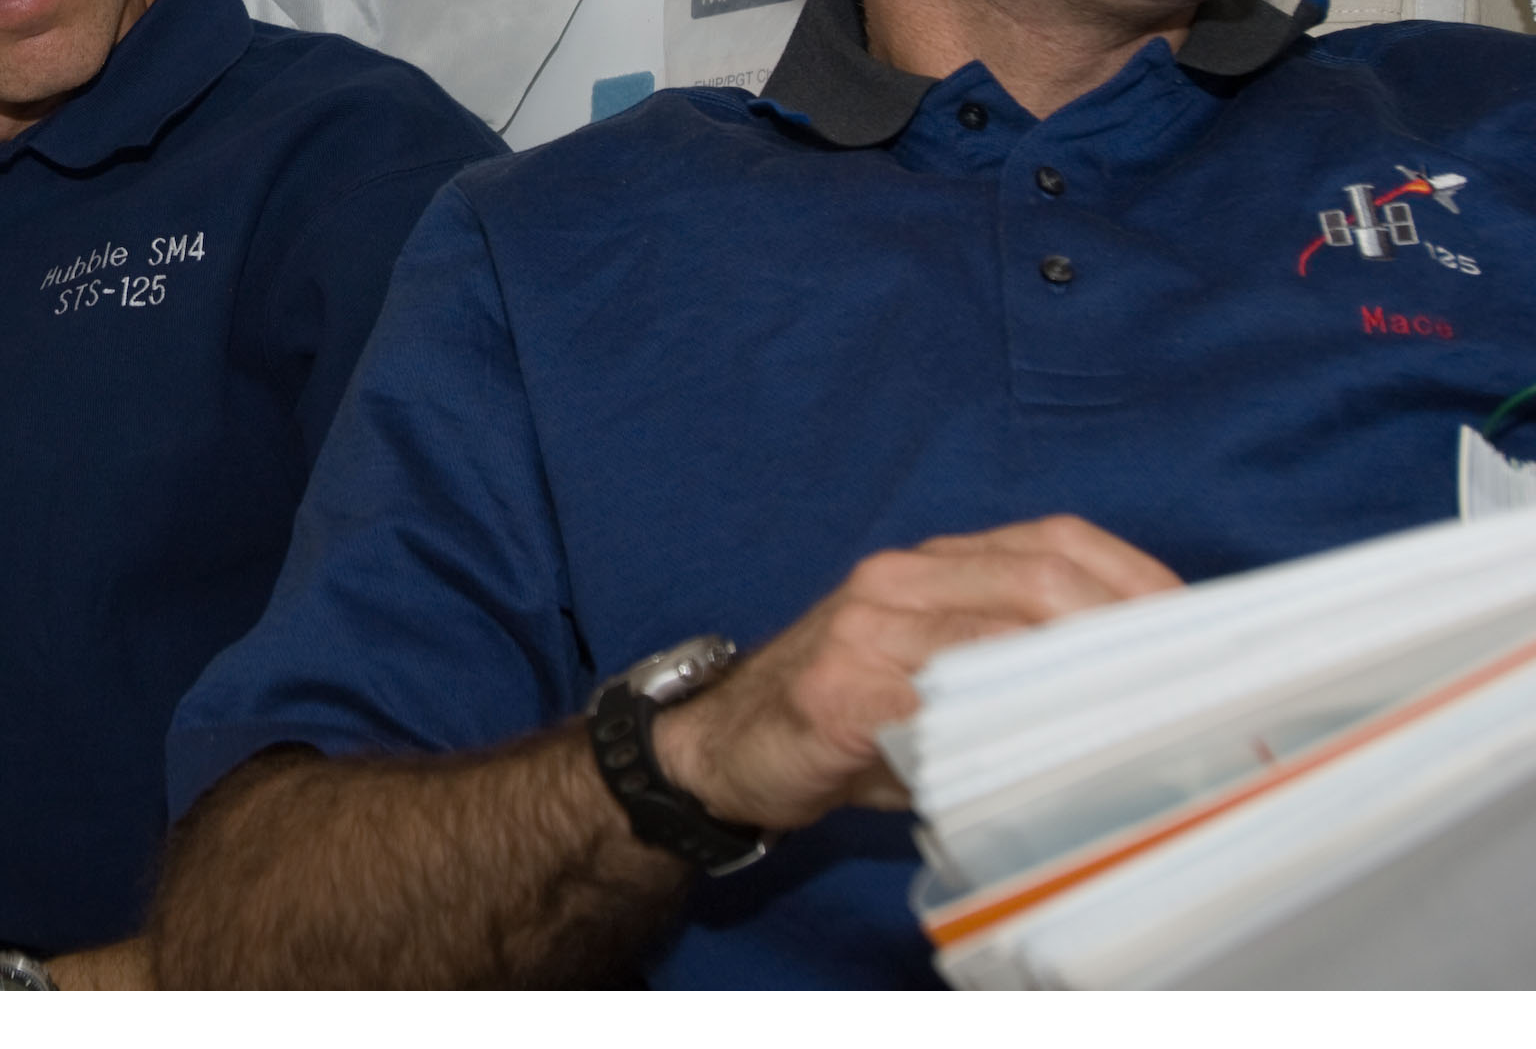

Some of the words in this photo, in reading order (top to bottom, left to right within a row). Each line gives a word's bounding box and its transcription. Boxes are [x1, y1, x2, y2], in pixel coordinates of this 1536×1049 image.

[40, 241, 129, 290] Hubble
[148, 231, 206, 266] SM4
[54, 275, 166, 315] STS-125
